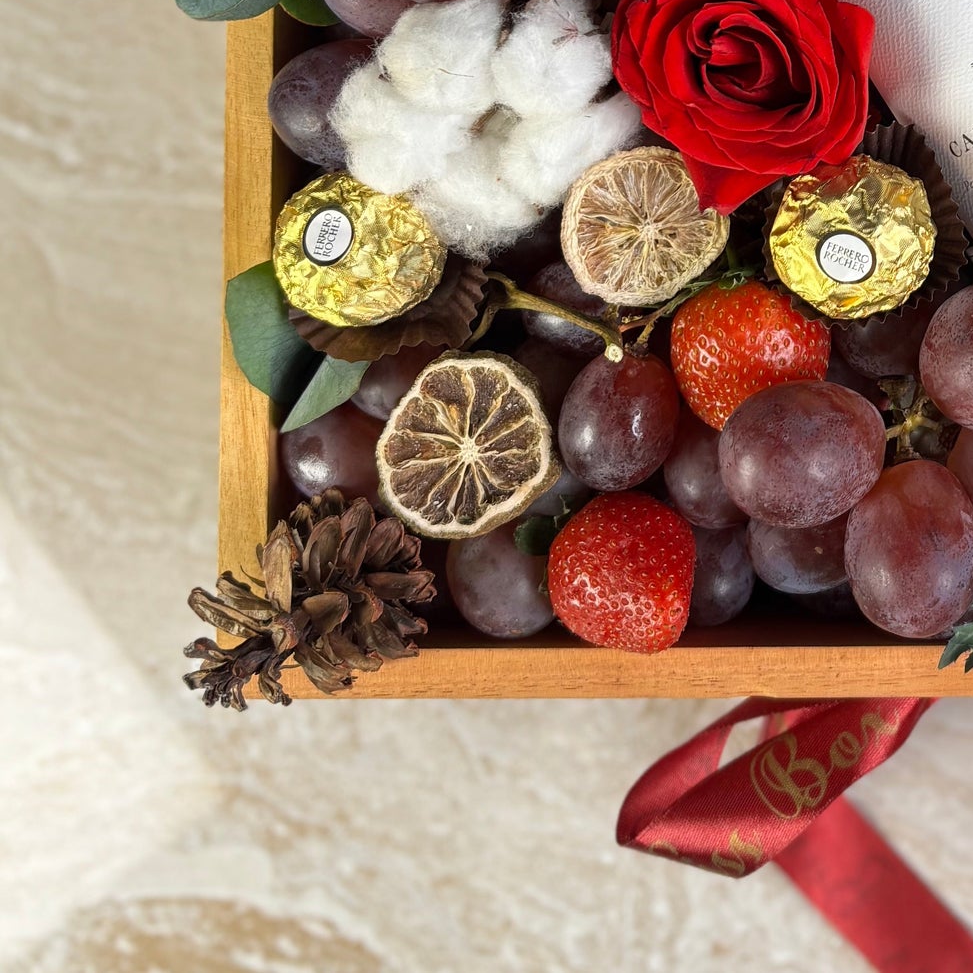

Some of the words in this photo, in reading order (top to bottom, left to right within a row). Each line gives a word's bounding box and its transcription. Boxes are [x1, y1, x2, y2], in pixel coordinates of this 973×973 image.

[313, 213, 332, 255] FERRERO
[322, 216, 342, 257] ROCHER
[827, 242, 869, 264] FERRERO
[824, 251, 865, 273] ROCHER
[751, 708, 900, 819] Box
